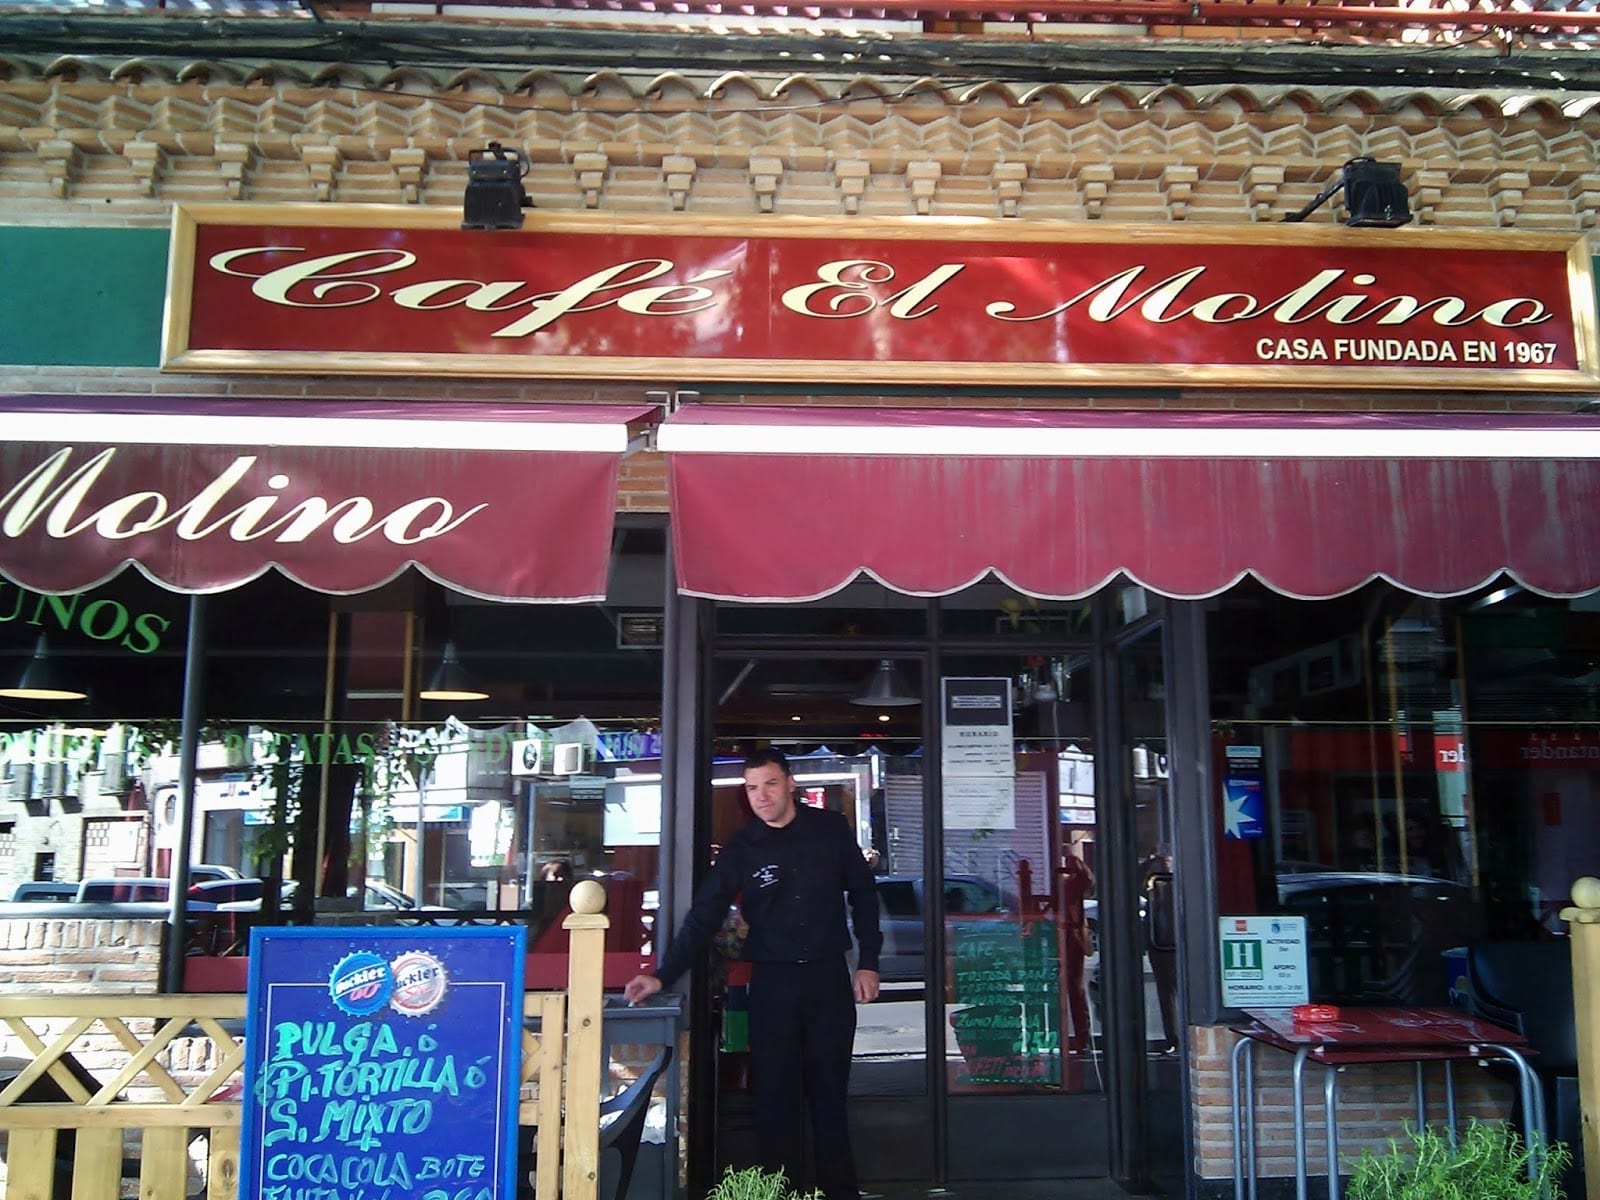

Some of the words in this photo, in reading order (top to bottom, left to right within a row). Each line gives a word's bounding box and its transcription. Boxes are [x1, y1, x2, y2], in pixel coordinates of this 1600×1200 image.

[209, 247, 733, 338] Café
[781, 259, 967, 320] El
[987, 264, 1555, 327] Molino
[1256, 337, 1329, 361] CASA
[1334, 338, 1458, 363] FUNDADA
[1463, 340, 1497, 363] EN
[1503, 341, 1558, 365] 1967
[0, 446, 489, 545] Molino
[1232, 942, 1257, 968] H
